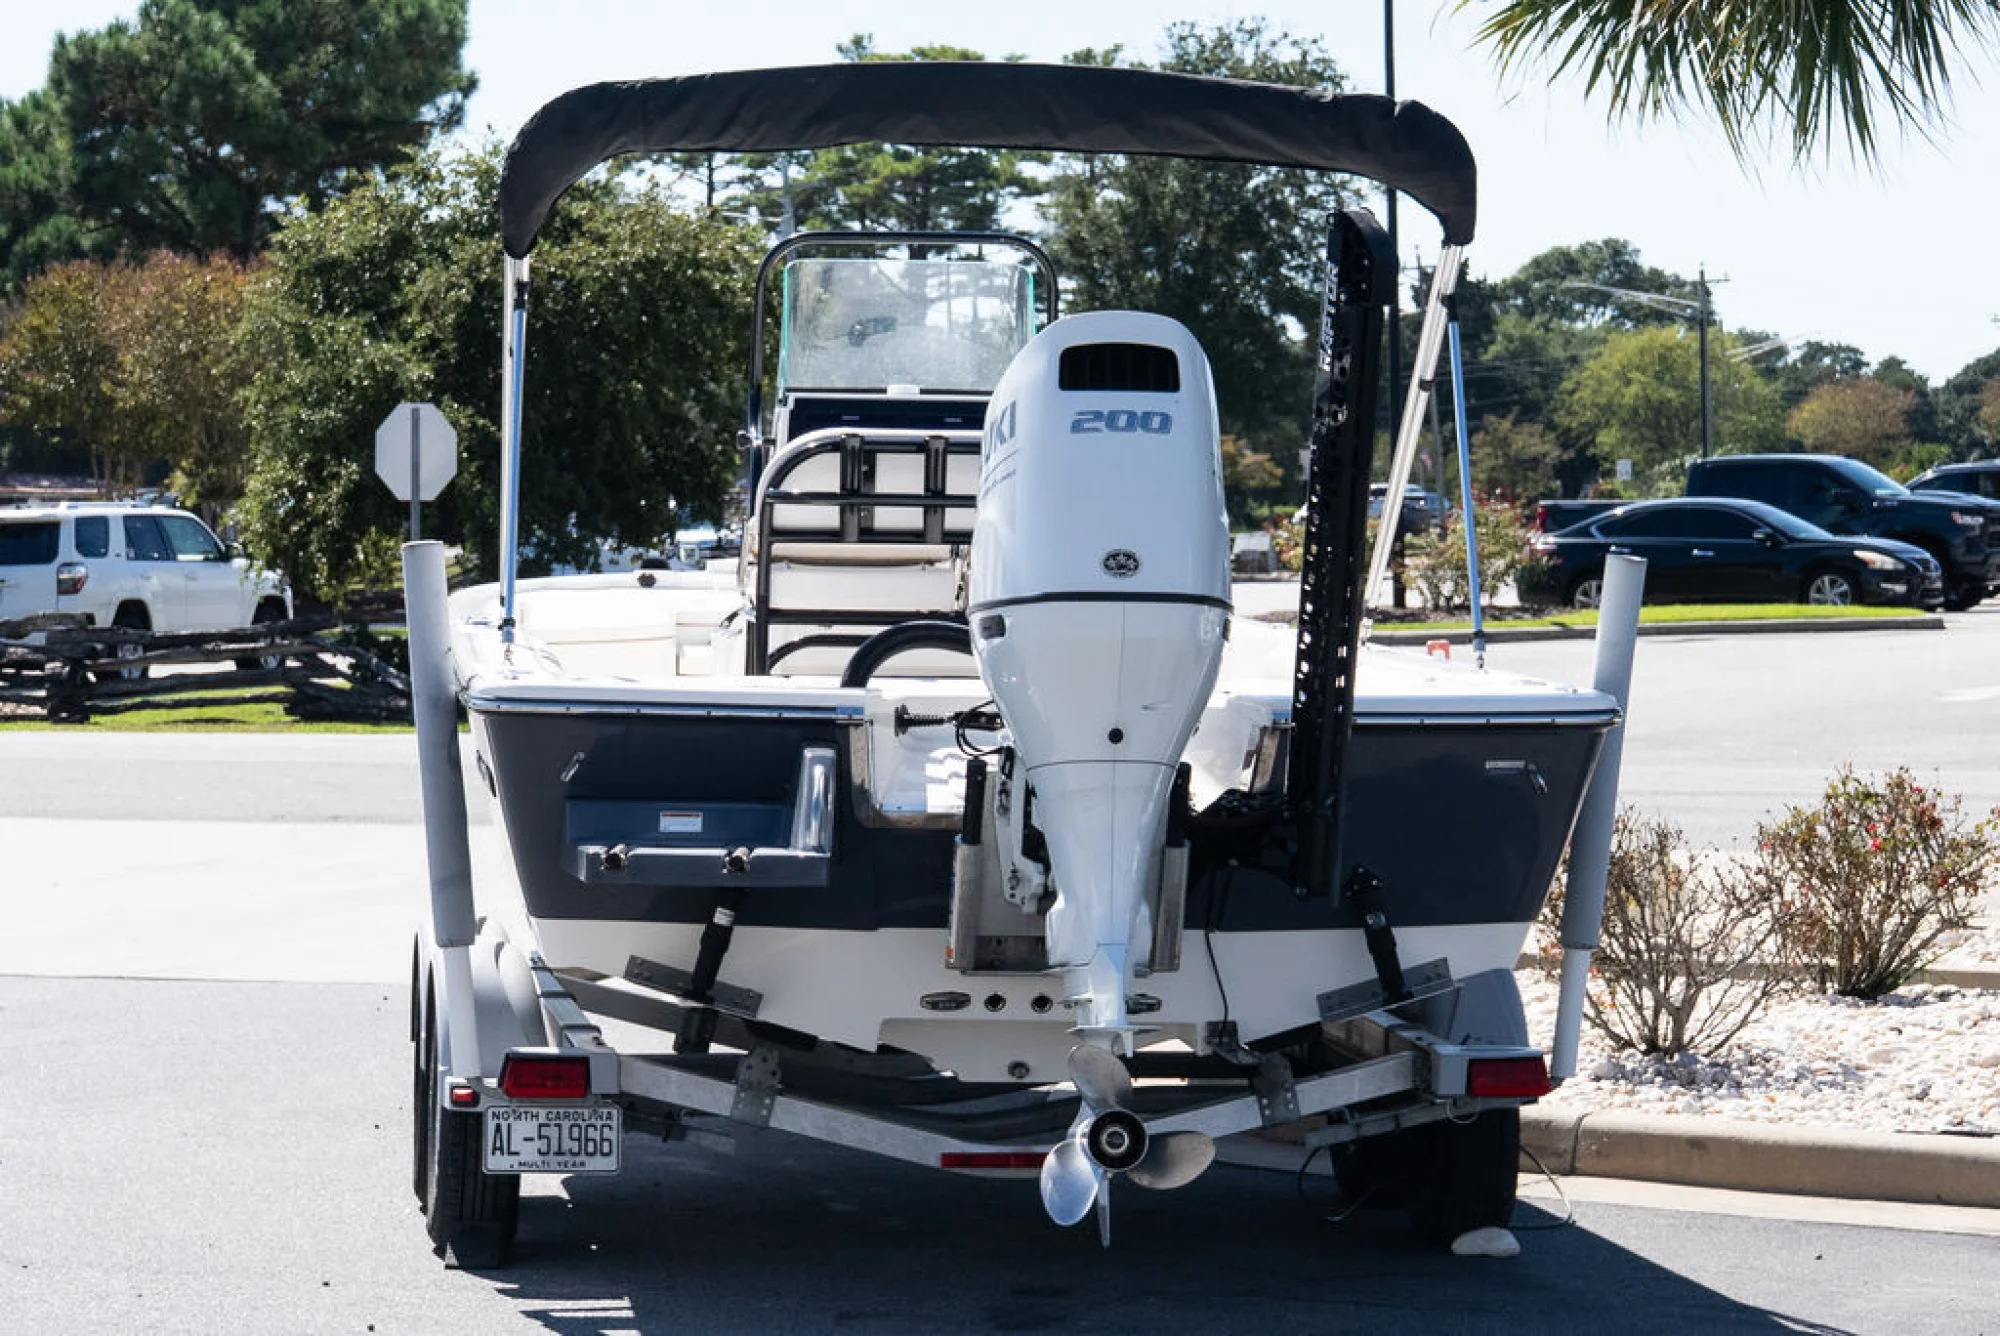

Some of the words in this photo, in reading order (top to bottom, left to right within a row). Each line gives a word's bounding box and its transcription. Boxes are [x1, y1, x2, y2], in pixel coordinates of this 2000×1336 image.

[1319, 260, 1339, 372] RAPTOR
[1070, 409, 1173, 435] 200
[491, 1123, 613, 1157] AL-51966
